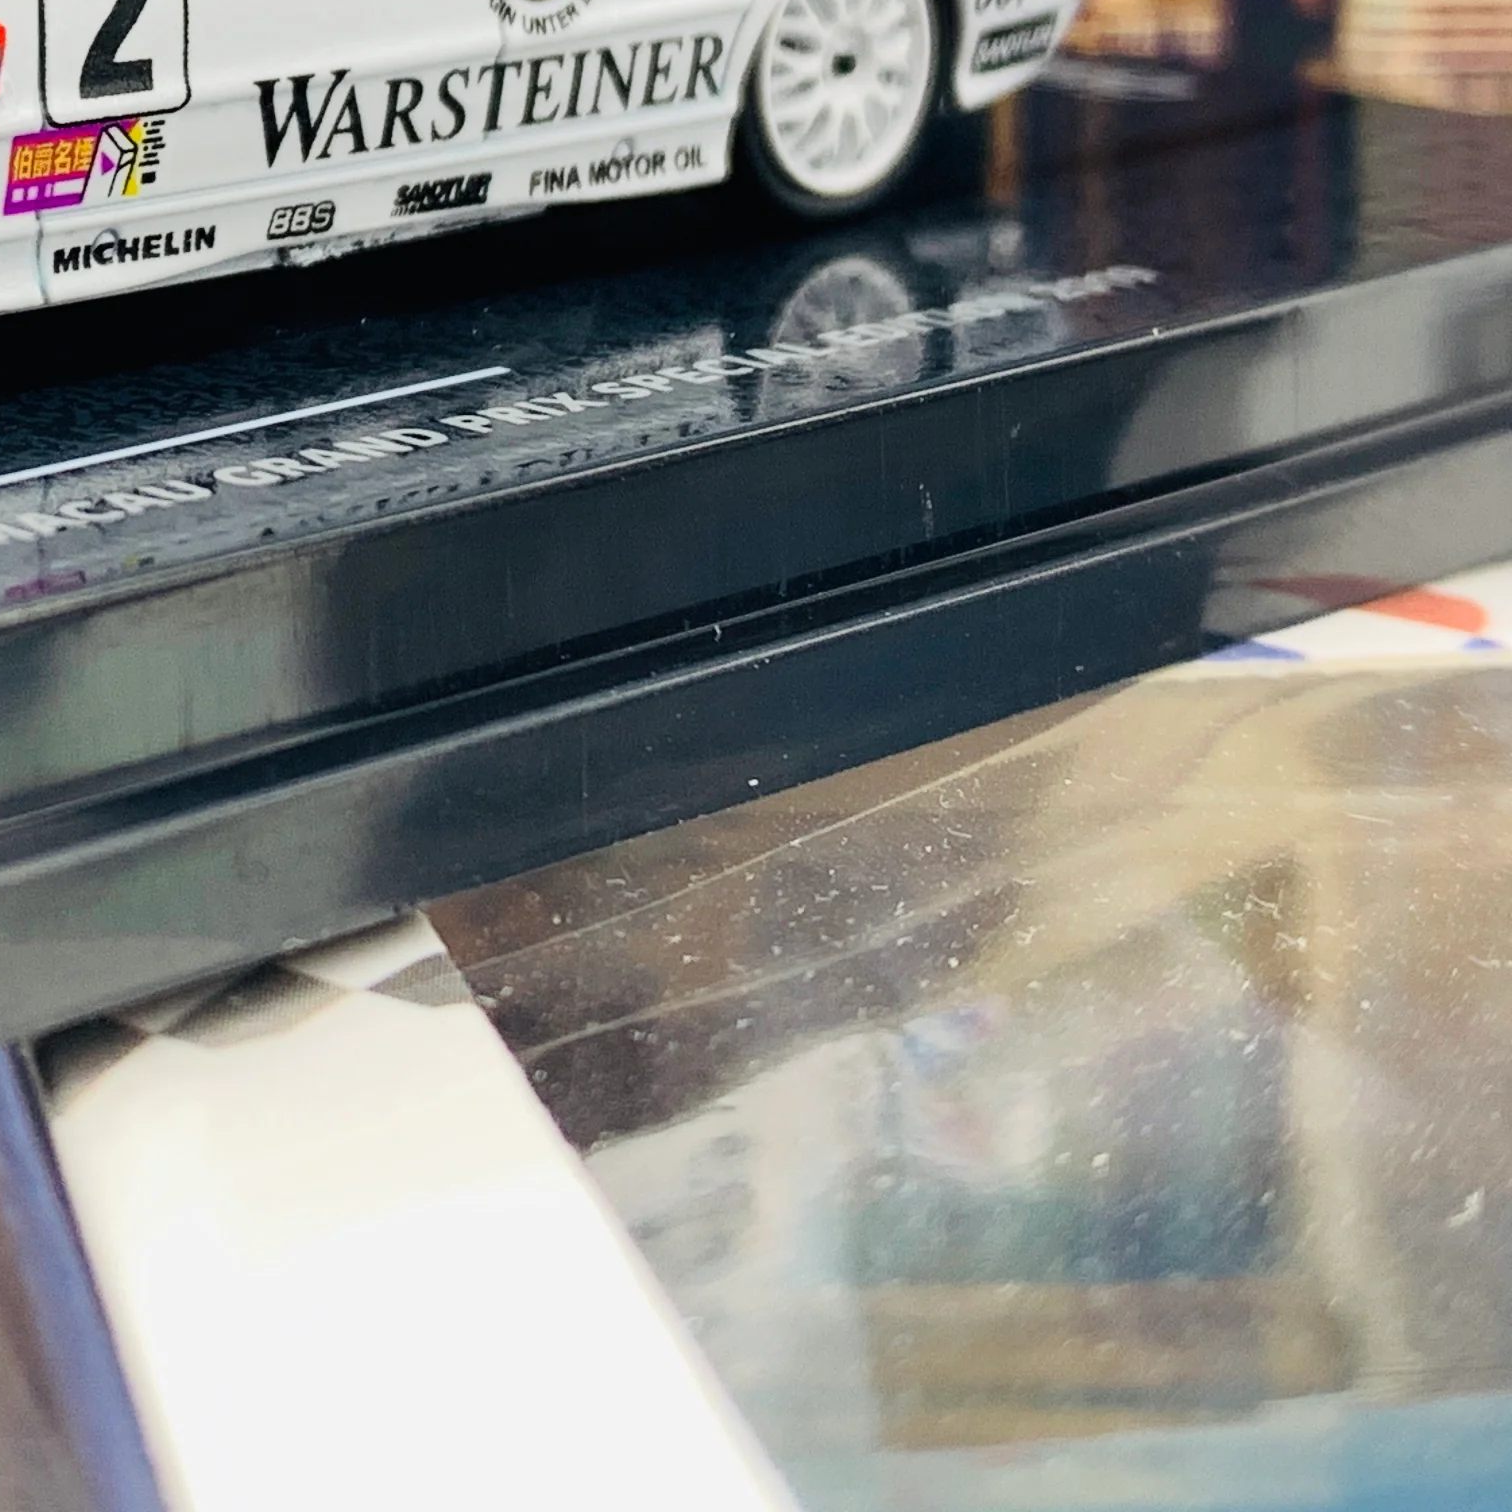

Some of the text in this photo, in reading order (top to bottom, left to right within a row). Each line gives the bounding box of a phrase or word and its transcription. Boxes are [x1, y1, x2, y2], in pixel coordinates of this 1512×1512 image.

[522, 3, 581, 35] UNTER
[253, 34, 725, 169] WARSTEINER
[529, 144, 705, 196] FINA MOTOR OIL
[52, 225, 217, 275] MICHELIN
[212, 427, 449, 489] GRAND
[439, 391, 610, 435] PRIX
[591, 341, 835, 401] SPECIAL
